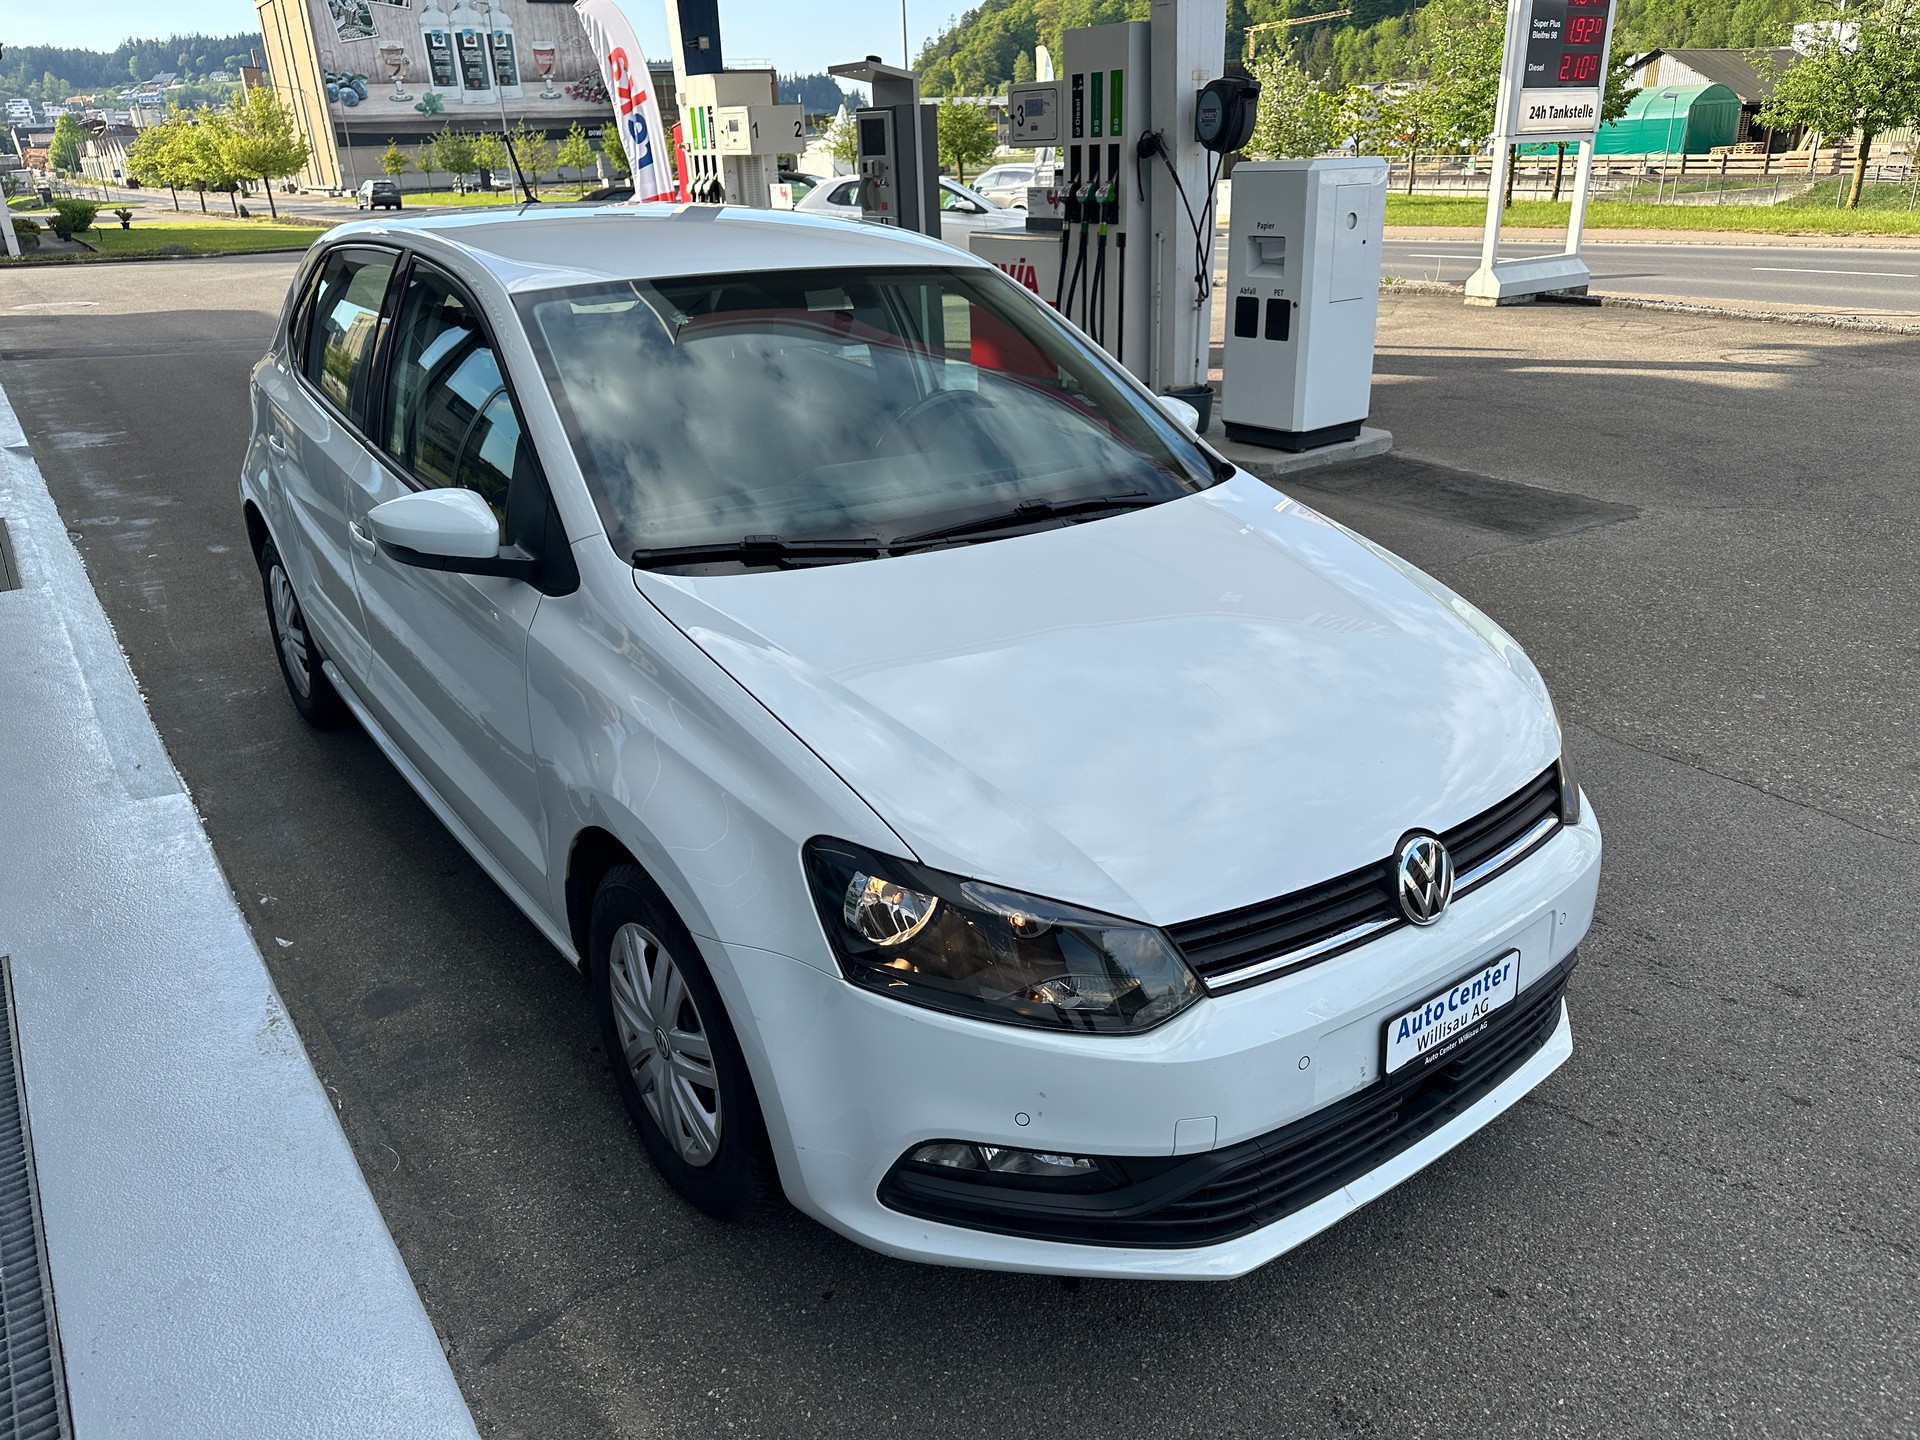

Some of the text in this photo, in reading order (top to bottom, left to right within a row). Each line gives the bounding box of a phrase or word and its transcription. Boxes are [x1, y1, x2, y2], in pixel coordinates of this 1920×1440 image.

[1533, 19, 1561, 29] Super Plus
[1532, 31, 1558, 40] Bleifrei 98
[1528, 63, 1544, 72] Diesel
[1016, 104, 1025, 127] 3
[1529, 104, 1594, 120] 24h Tankstelle
[752, 121, 759, 138] 1
[794, 120, 802, 138] 2
[1257, 221, 1275, 231] Papier
[992, 257, 1039, 294] VIA
[1239, 286, 1257, 296] Abfall
[1273, 288, 1285, 297] PET
[1396, 961, 1511, 1045] Auto Center
[1416, 997, 1490, 1053] Willisau AG
[1424, 1021, 1489, 1066] Auto Center Willisau AG
